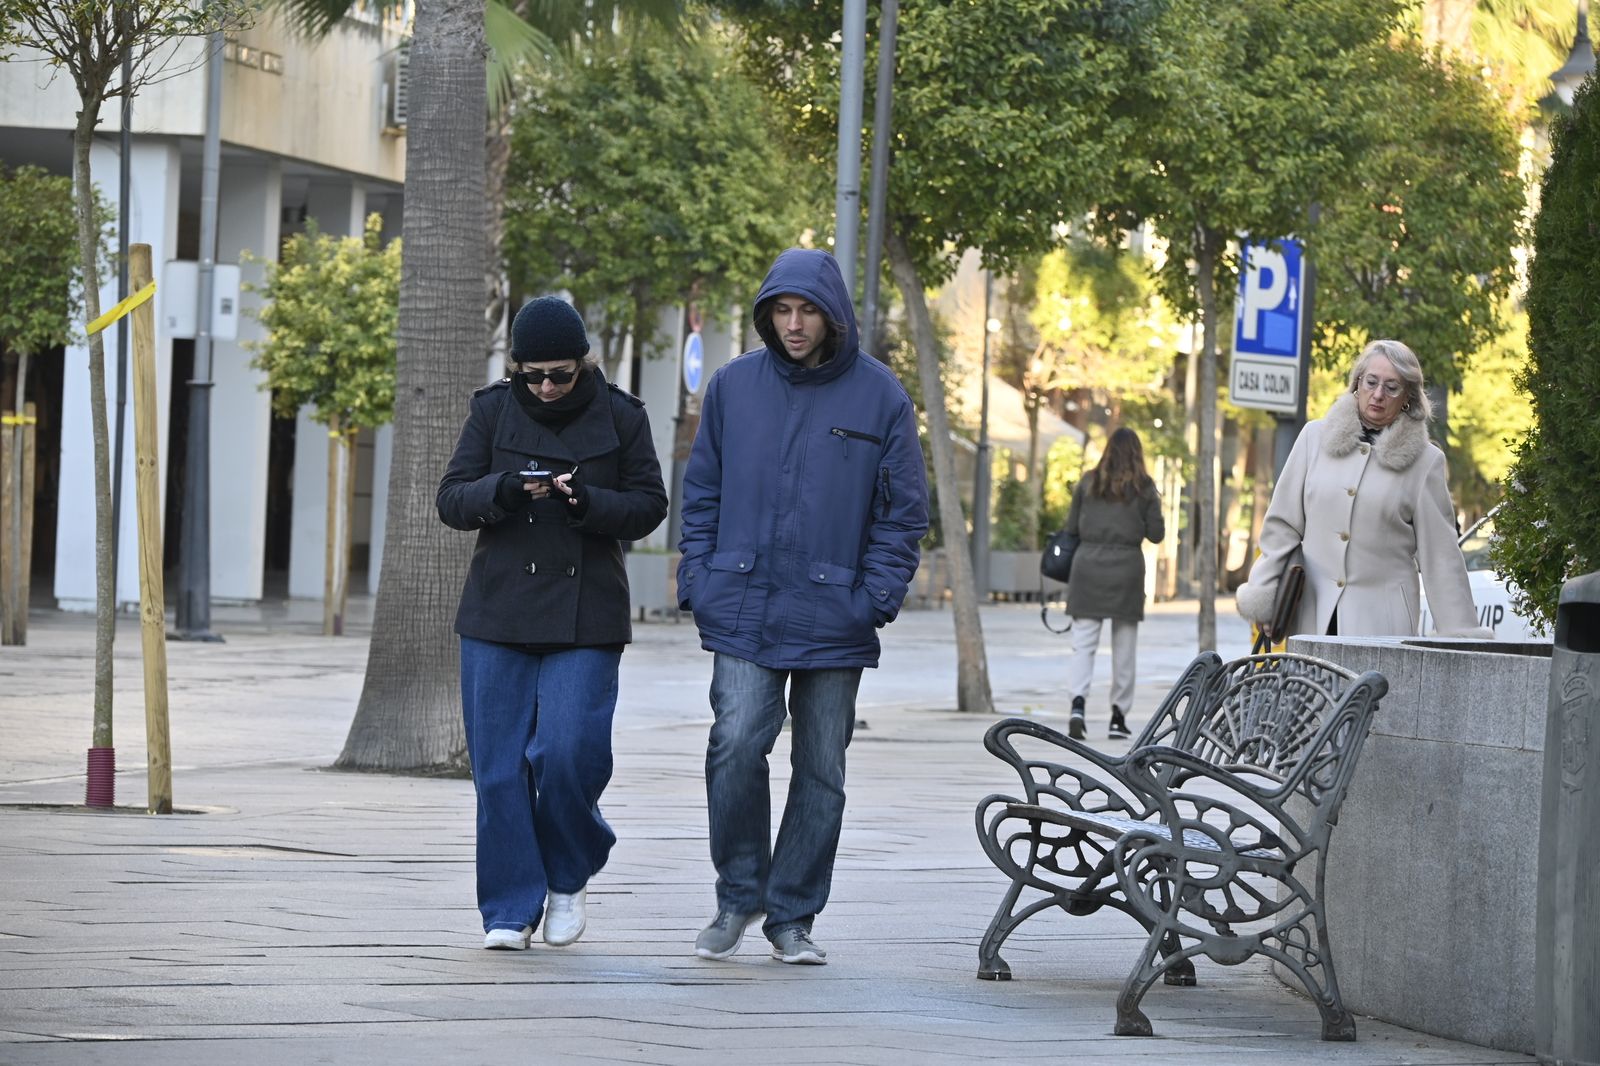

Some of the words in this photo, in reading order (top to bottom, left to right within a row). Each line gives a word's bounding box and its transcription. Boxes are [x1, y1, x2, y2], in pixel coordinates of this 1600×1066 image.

[1242, 245, 1288, 340] P
[1239, 371, 1260, 391] CASA
[1263, 373, 1291, 395] COLON
